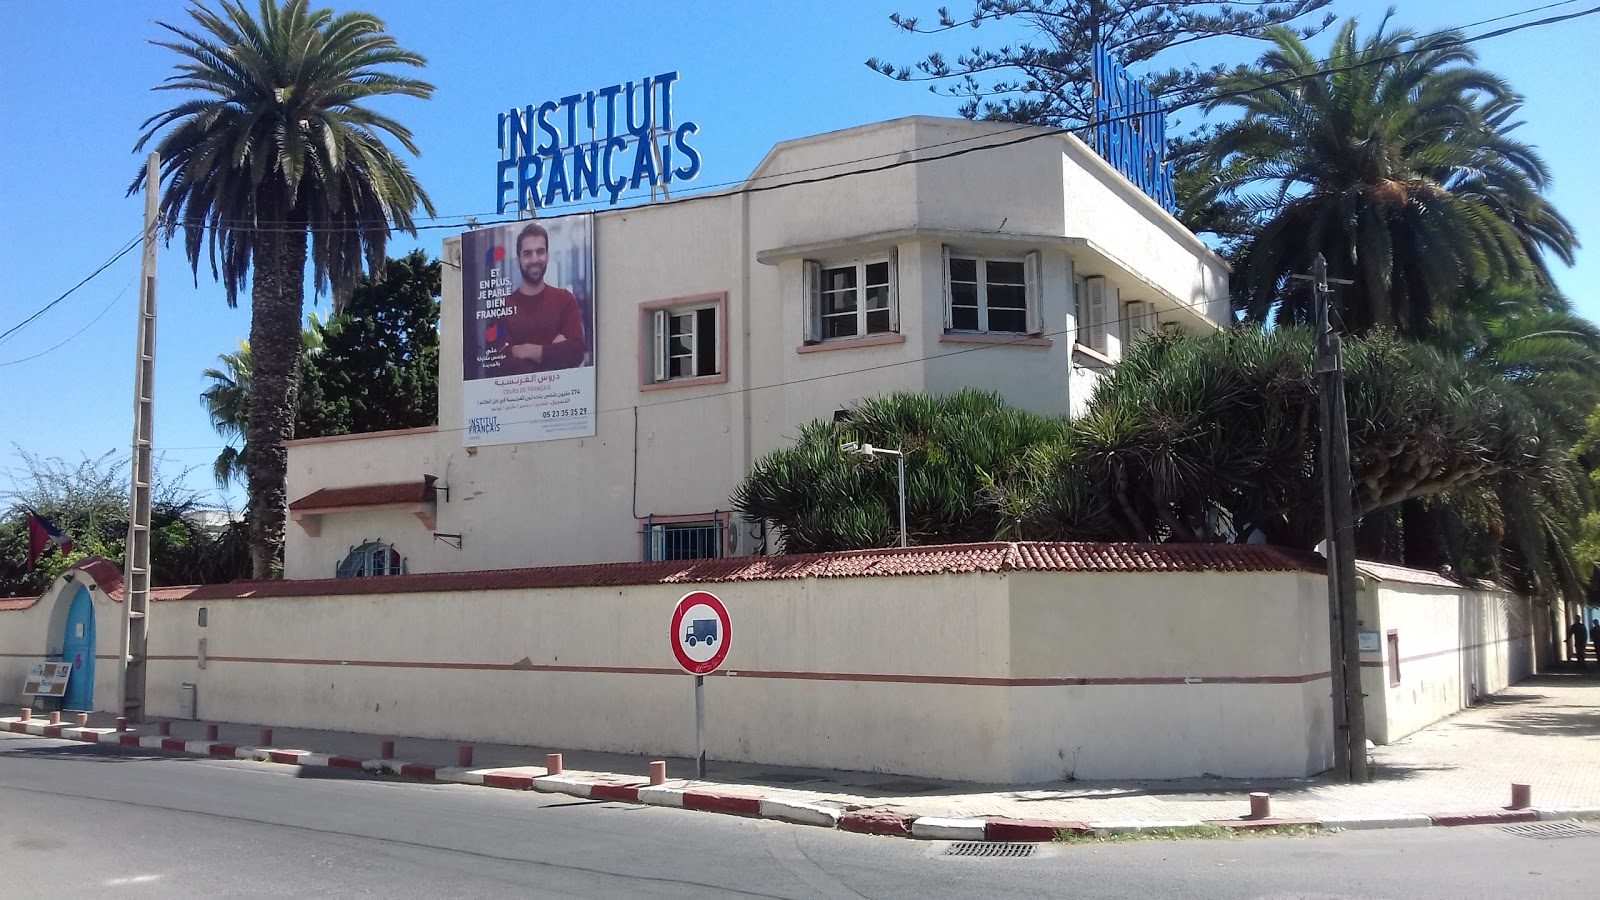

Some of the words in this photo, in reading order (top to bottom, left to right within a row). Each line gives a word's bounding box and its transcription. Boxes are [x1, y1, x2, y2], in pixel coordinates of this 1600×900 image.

[497, 71, 680, 160] INSTITUT
[497, 122, 701, 215] FRANÇAIS
[490, 268, 500, 277] ET
[480, 280, 490, 289] EN
[491, 277, 512, 287] PLUS,
[478, 290, 487, 299] JE
[488, 287, 511, 298] PARLE
[486, 298, 505, 308] BIEN
[495, 375, 537, 386] الفرنسية
[538, 374, 560, 383] دروس
[570, 408, 578, 416] 35
[579, 407, 587, 415] 29
[469, 416, 497, 427] INSTITUT
